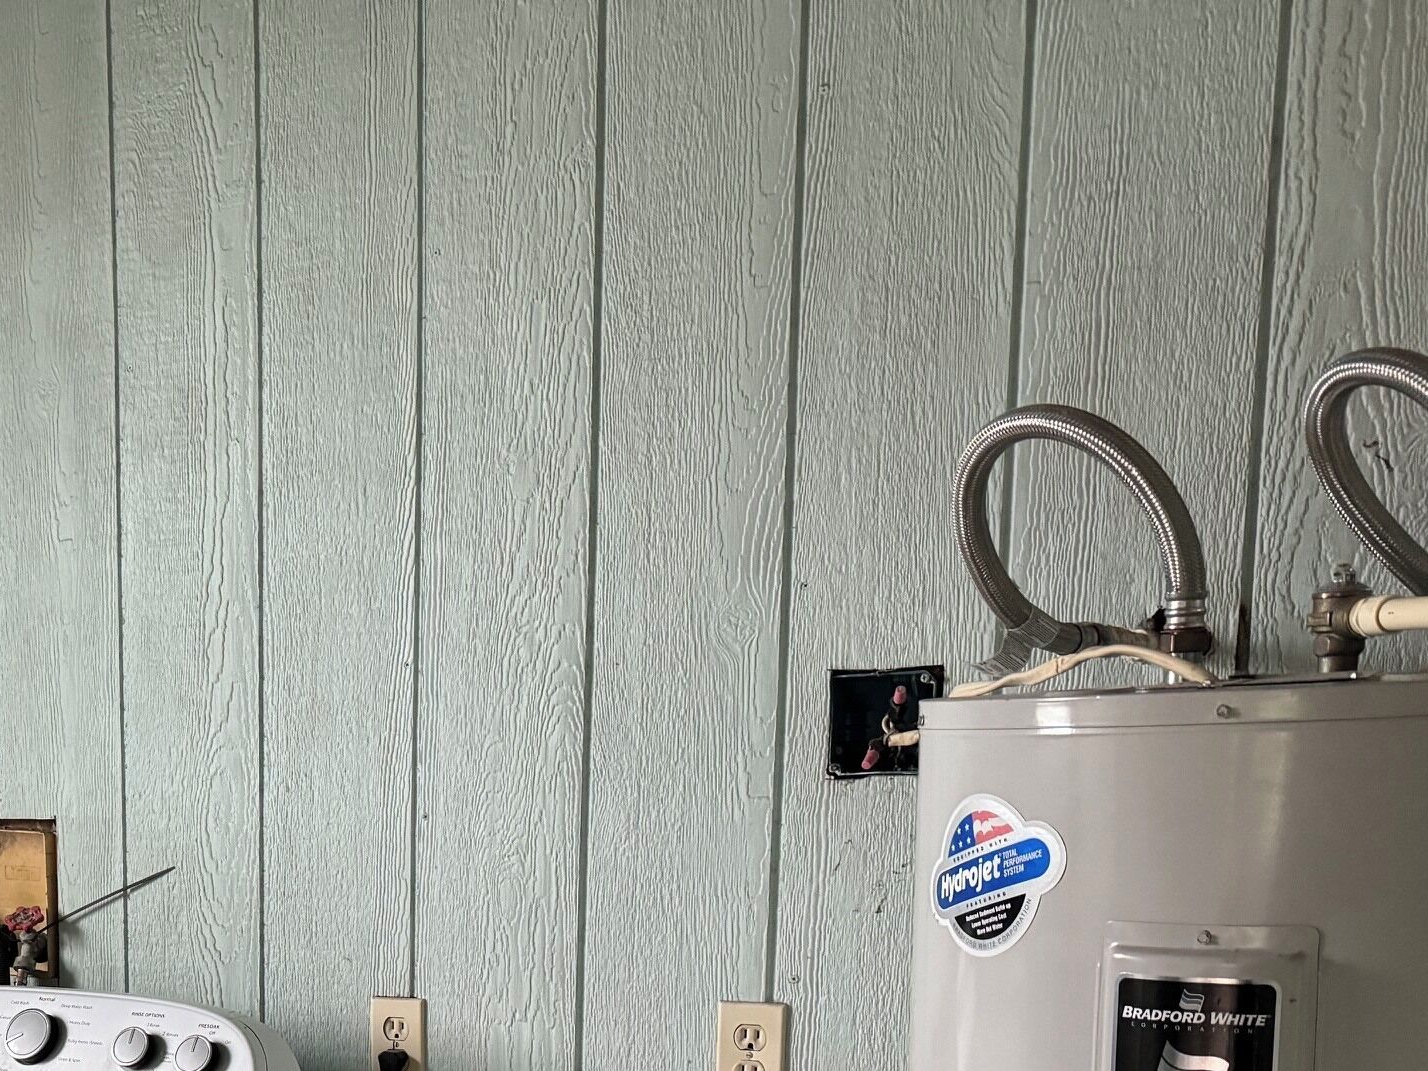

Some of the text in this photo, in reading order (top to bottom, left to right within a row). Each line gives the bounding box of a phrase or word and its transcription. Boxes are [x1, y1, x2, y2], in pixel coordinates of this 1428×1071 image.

[953, 838, 1008, 863] EQUIPPED WITH
[1002, 849, 1017, 859] TOTAL
[941, 849, 1042, 902] Hydrojet PERFORMANCE
[1003, 864, 1024, 877] SYSTEM
[966, 892, 1007, 908] FEATURING
[977, 941, 996, 950] WHITE
[998, 898, 1032, 944] CORPORATION
[1122, 1005, 1267, 1027] BRADFORD WHITE
[1131, 1021, 1253, 1034] CORPORATION
